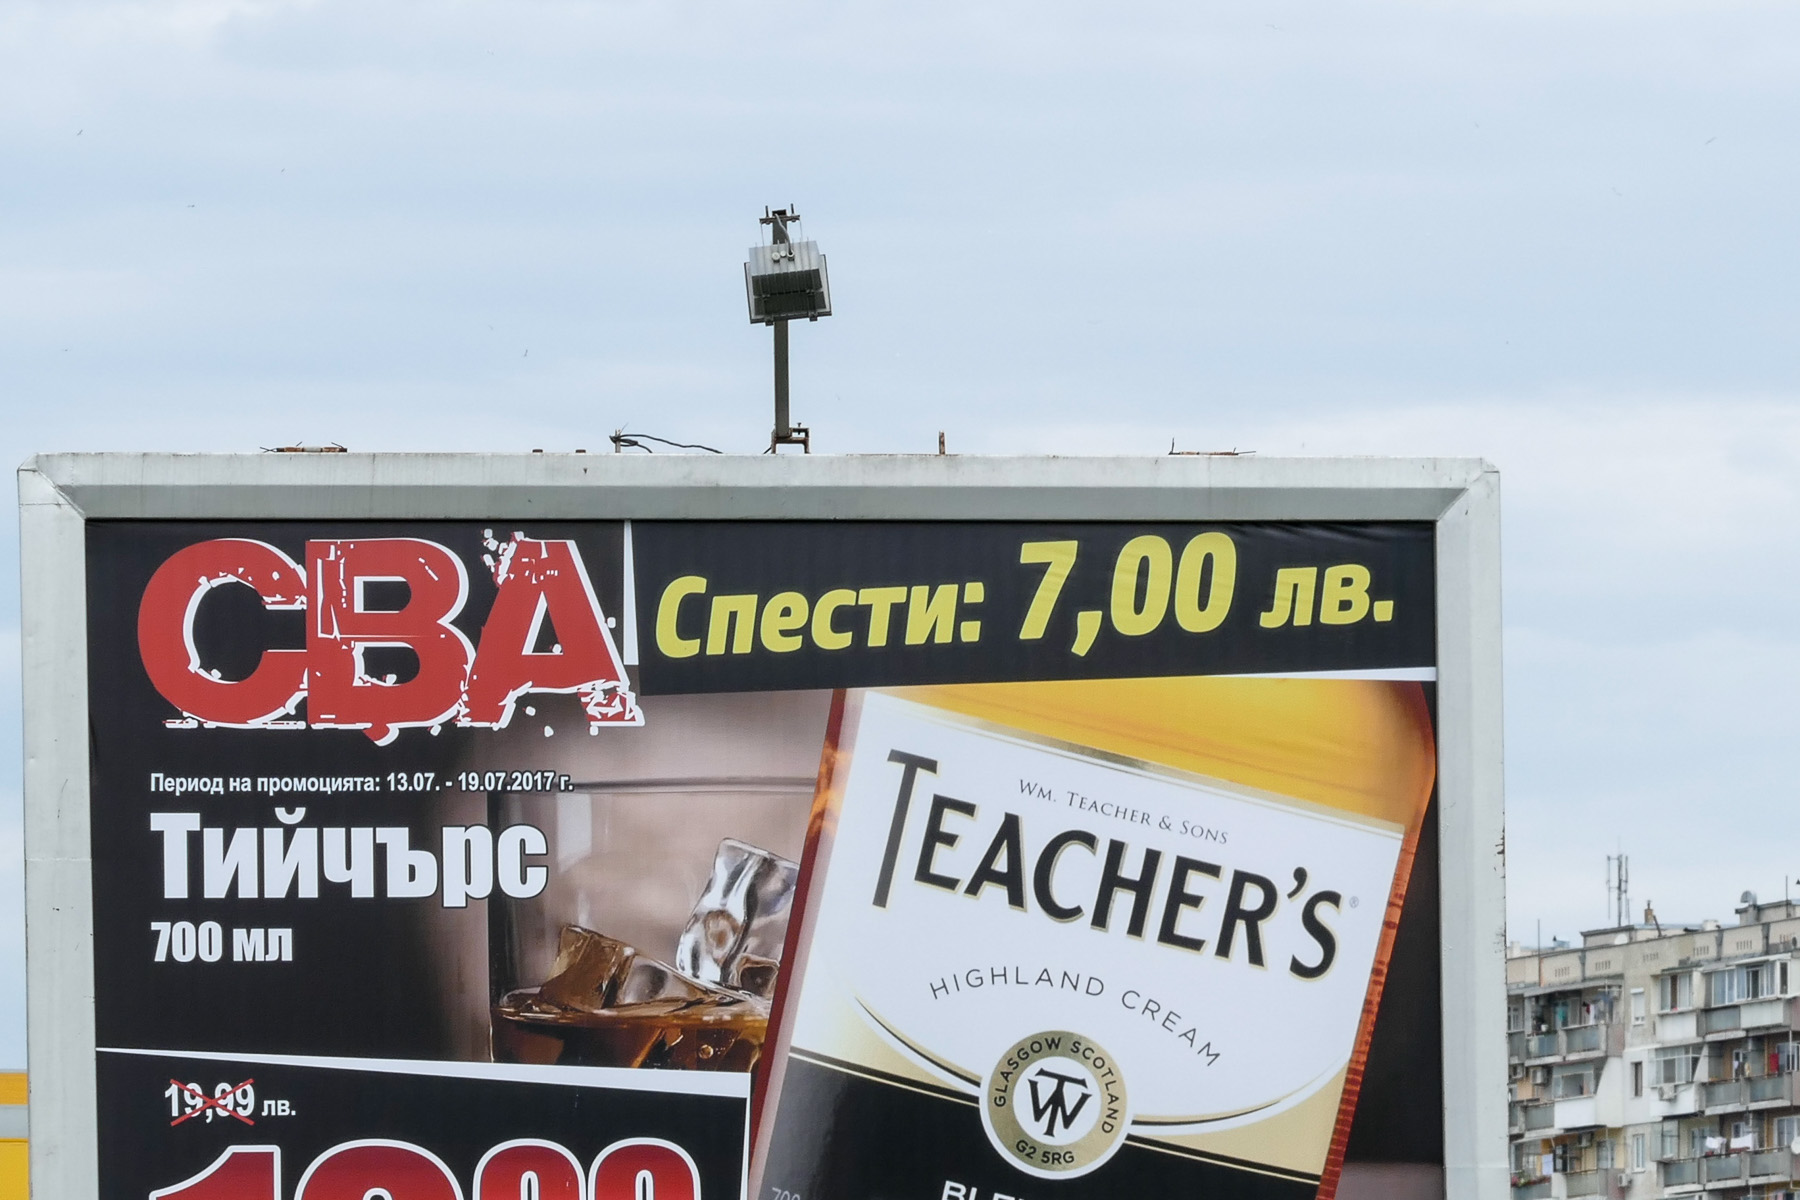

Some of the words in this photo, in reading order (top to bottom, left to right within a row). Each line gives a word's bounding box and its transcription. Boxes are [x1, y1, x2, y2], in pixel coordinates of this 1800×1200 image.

[656, 575, 984, 658] Спести:
[1018, 531, 1237, 657] 7,00
[1259, 563, 1395, 627] лв.
[150, 772, 224, 796] Период
[229, 777, 251, 792] на
[257, 777, 380, 796] промоцията:
[387, 771, 440, 791] 13.07.
[458, 770, 554, 791] 19.07.2017
[559, 774, 574, 791] г.
[150, 806, 549, 908] Тийчърс
[1158, 815, 1172, 832] &
[872, 748, 1344, 982] TEACHER'S
[151, 920, 223, 962] 700
[232, 927, 294, 962] мл
[929, 966, 1105, 1000] HIGHLAND
[1121, 990, 1221, 1067] CREAM
[164, 1082, 255, 1124] 19,99
[262, 1096, 297, 1117] лв.
[994, 1037, 1062, 1108] GLASGOW
[1070, 1041, 1120, 1134] SCOTLAND
[1016, 1139, 1037, 1160] G2
[1041, 1150, 1075, 1165] 5RG
